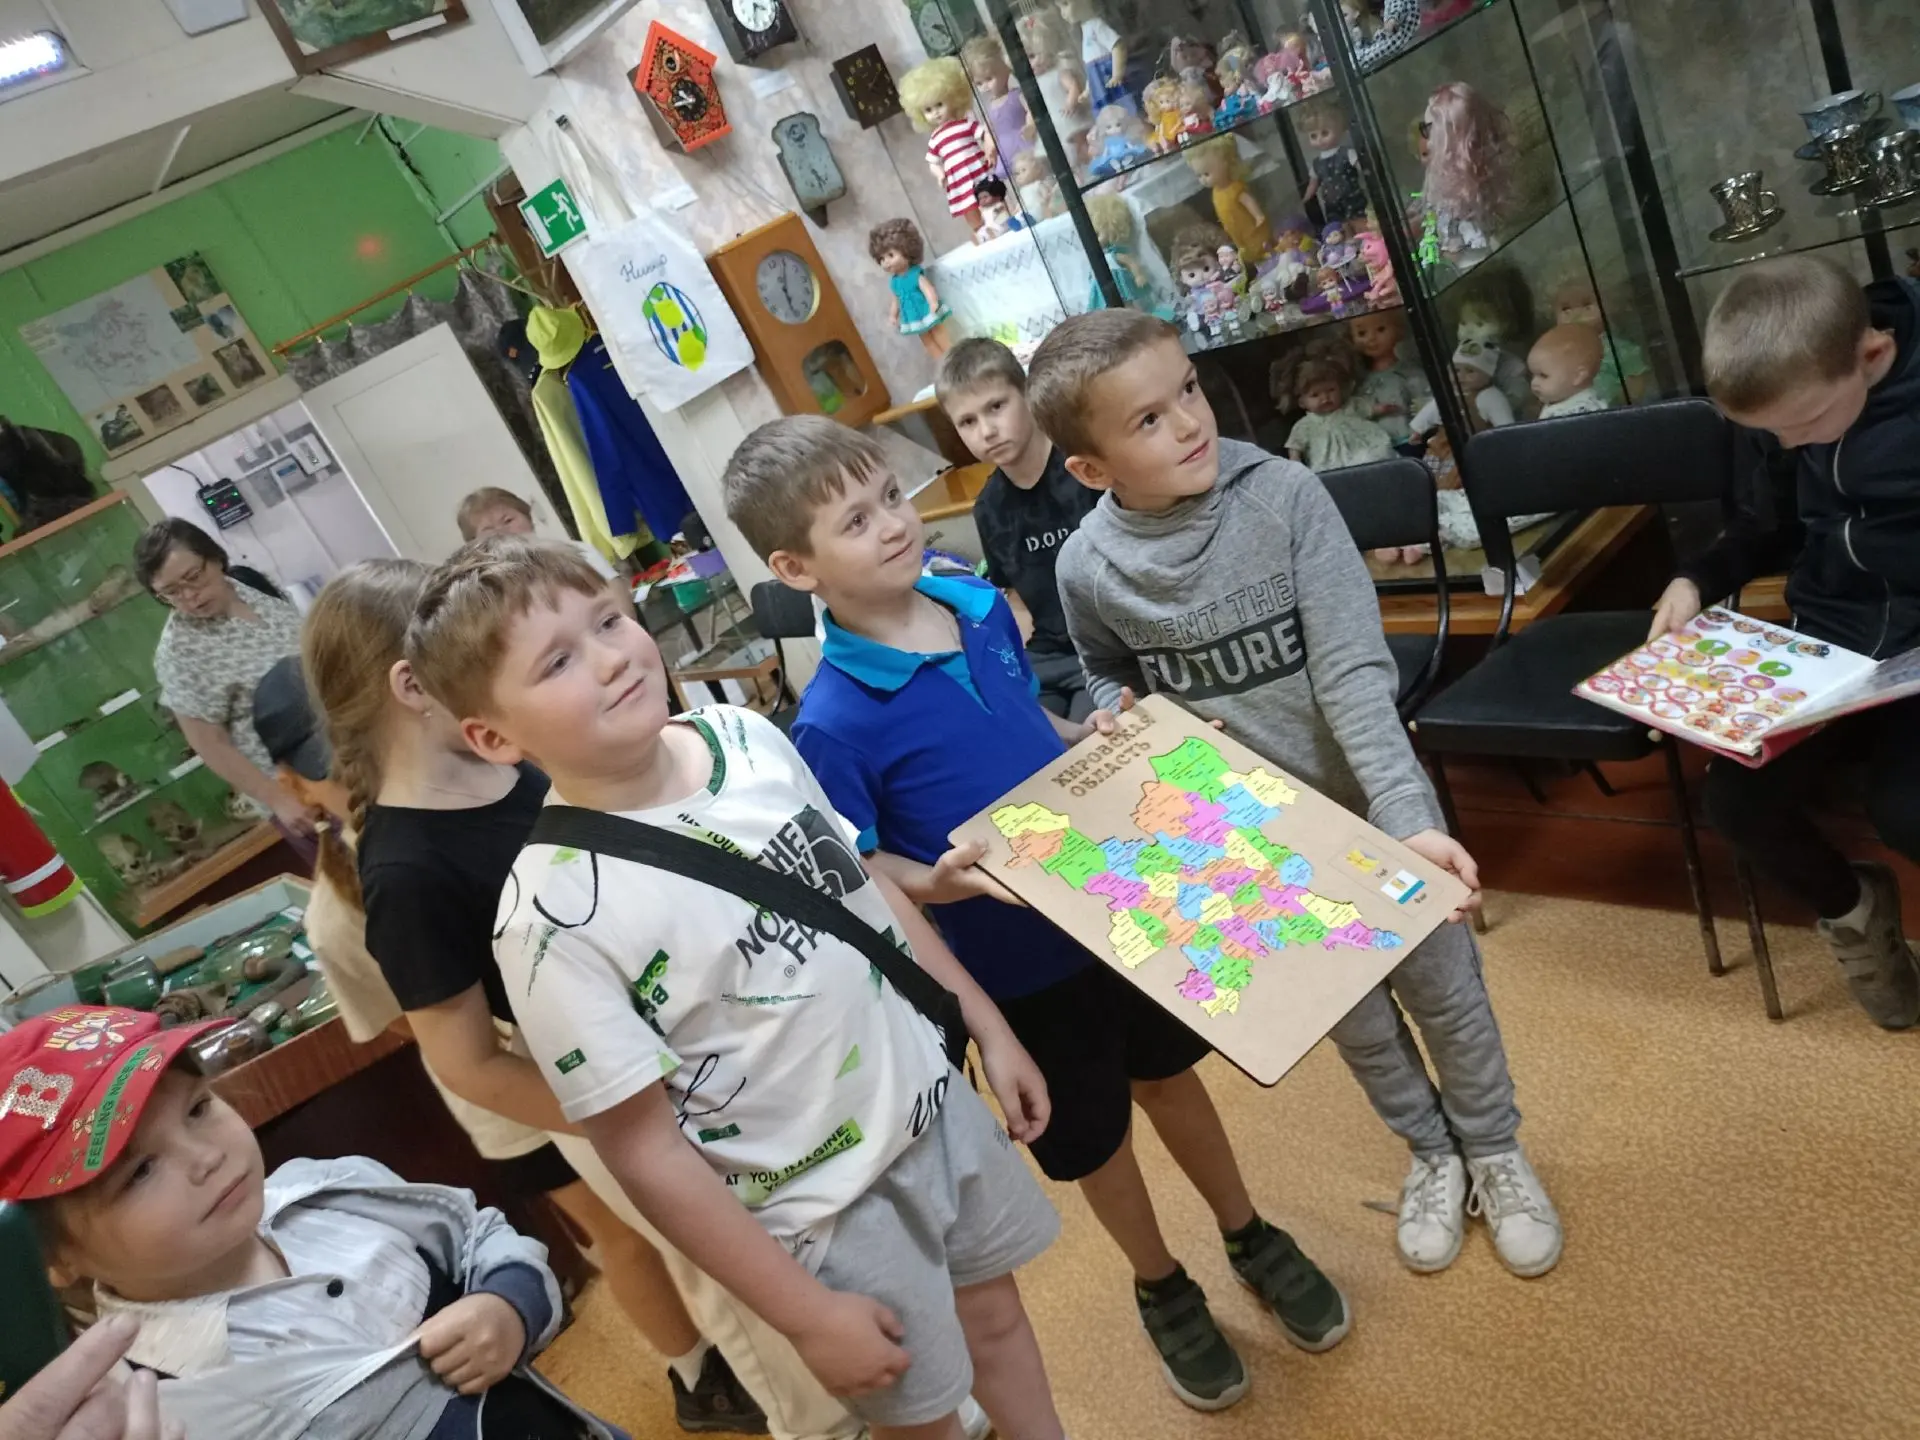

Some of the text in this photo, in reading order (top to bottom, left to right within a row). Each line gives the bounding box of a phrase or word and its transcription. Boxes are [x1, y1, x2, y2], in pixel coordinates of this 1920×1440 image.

[1225, 573, 1296, 623] THE
[1137, 617, 1303, 694] FUTURE
[1070, 742, 1150, 797] ОБЛАСТЬ
[752, 821, 809, 876] HE
[0, 1066, 74, 1130] B
[87, 1101, 114, 1166] FEELING
[749, 1171, 779, 1192] YOU
